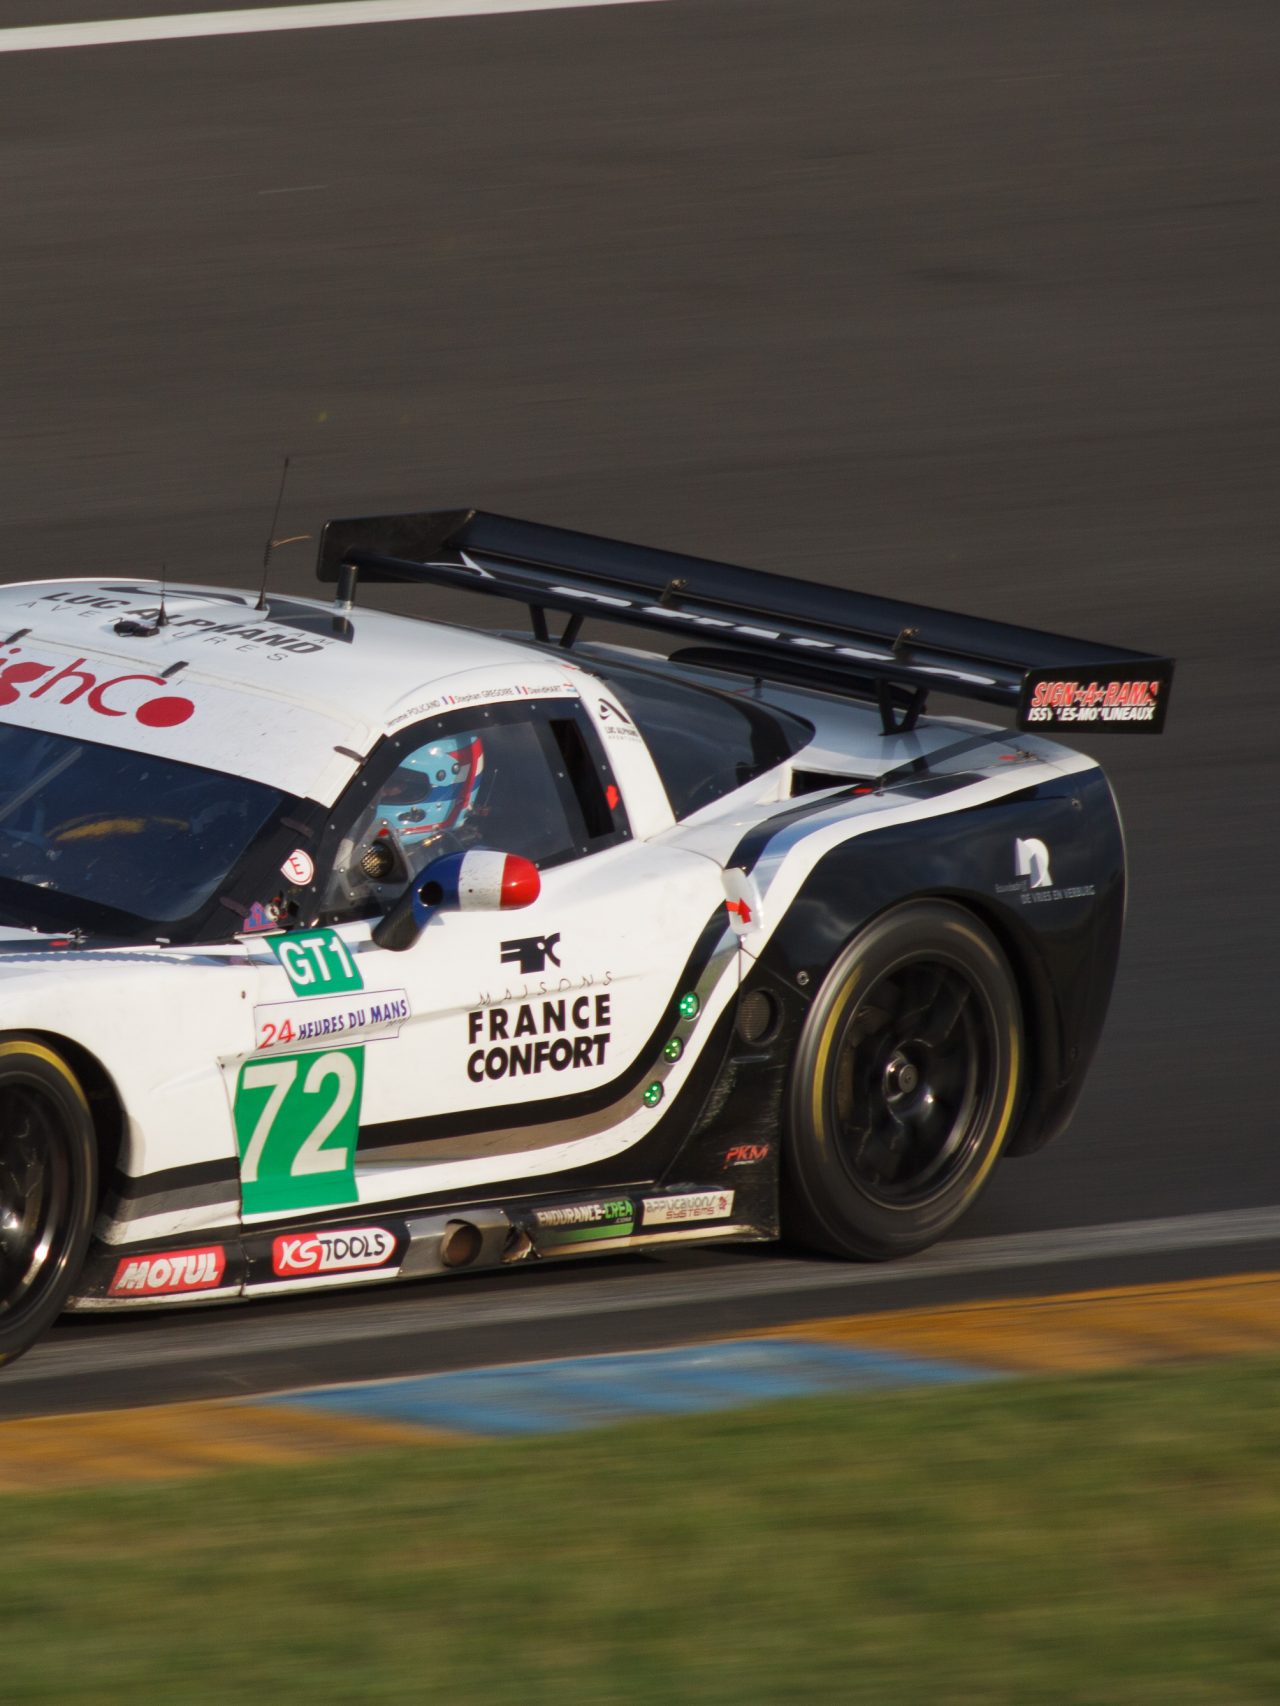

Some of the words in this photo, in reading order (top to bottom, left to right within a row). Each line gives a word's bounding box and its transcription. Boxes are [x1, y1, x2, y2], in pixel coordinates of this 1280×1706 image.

[40, 592, 131, 609] LUC
[288, 857, 303, 876] E
[278, 936, 354, 985] GT1
[258, 1019, 296, 1050] 24
[298, 1014, 345, 1040] HEURES
[348, 1009, 366, 1028] DU
[370, 1000, 407, 1024] MANS
[469, 994, 611, 1044] FRANCE
[467, 1033, 611, 1083] CONFORT
[241, 1052, 357, 1183] 72
[115, 1253, 219, 1290] MOTUL
